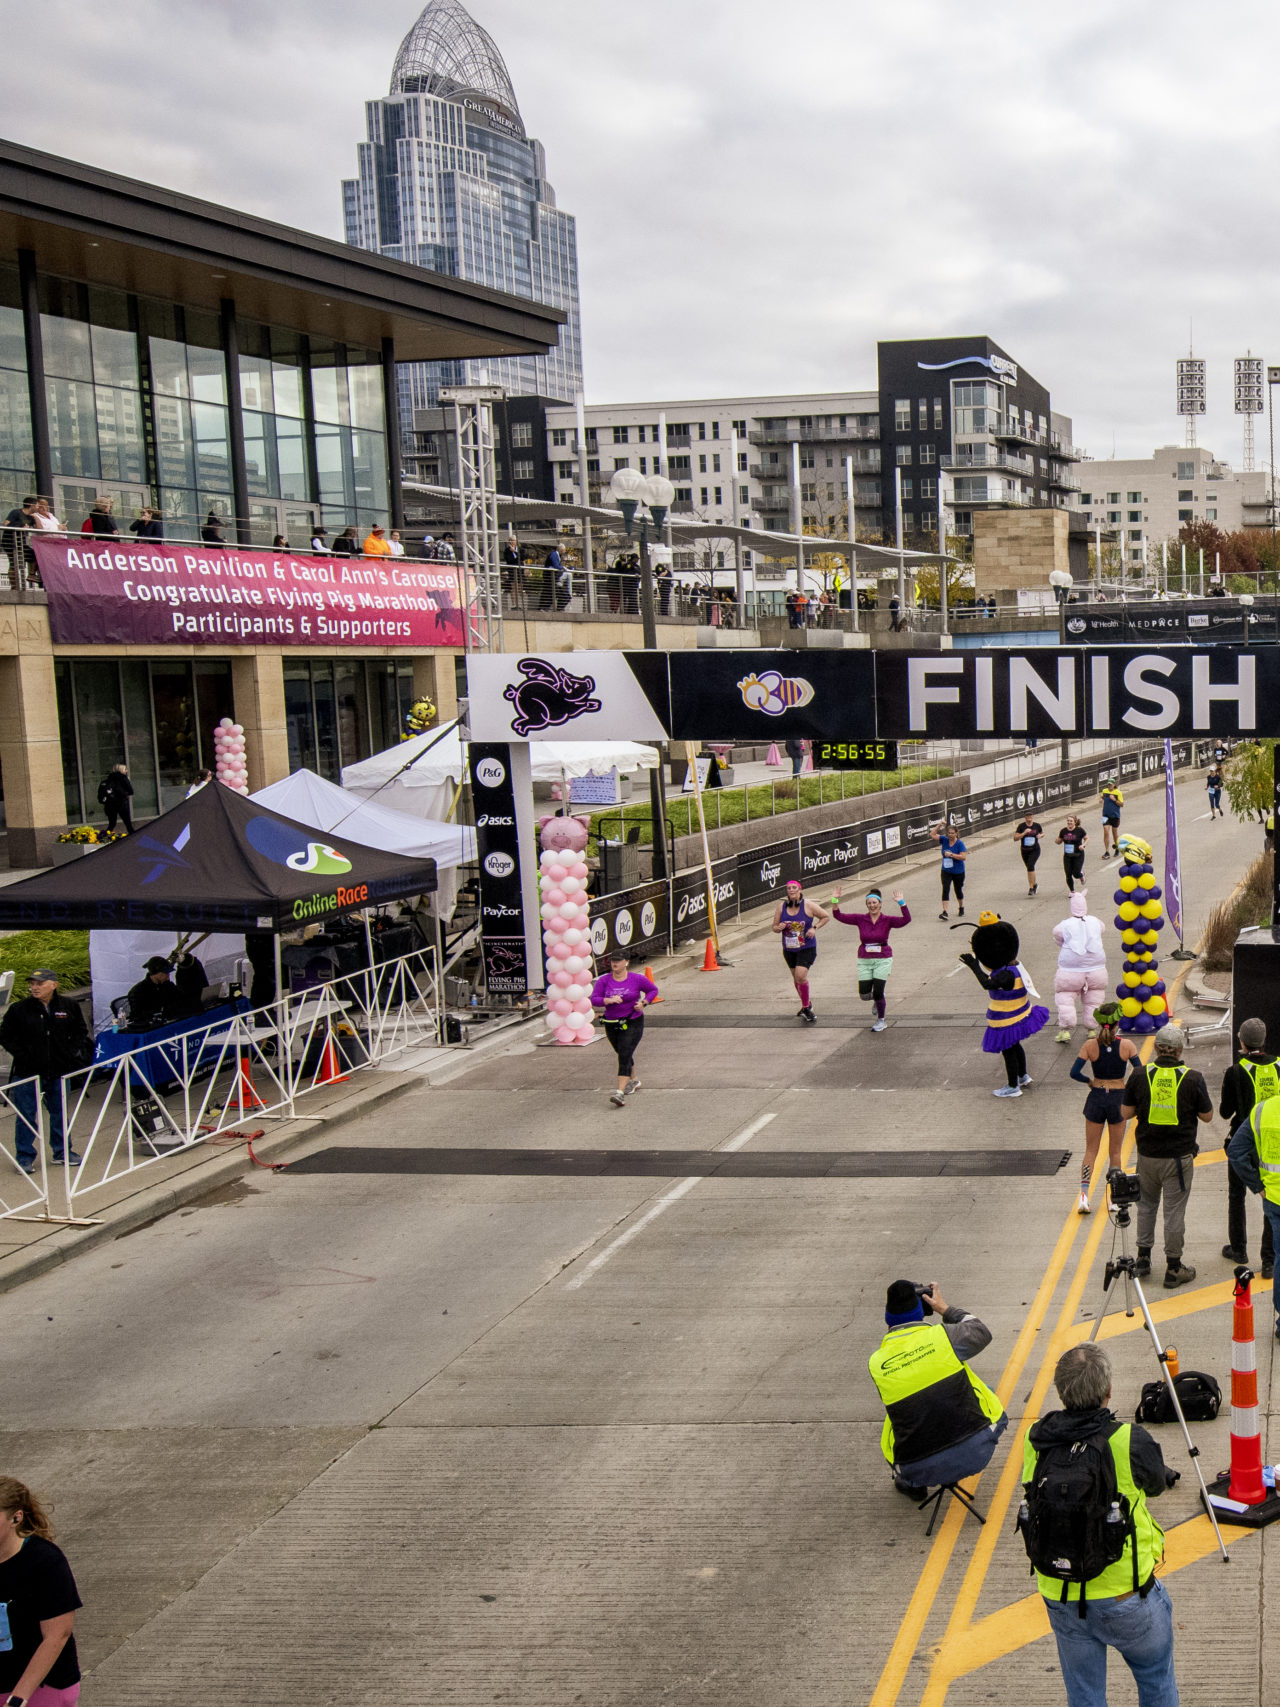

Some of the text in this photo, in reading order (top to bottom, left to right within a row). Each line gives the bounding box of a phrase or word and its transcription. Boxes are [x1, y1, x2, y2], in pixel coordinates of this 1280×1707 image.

[67, 548, 459, 589] Anderson Pavilion & Carol Ann's Carousel
[123, 580, 437, 612] Congratulate Flying Pig Marathon
[172, 611, 411, 638] Participants & Supporters
[1129, 618, 1180, 628] MEDPACE
[907, 655, 1256, 732] FINISH
[482, 767, 502, 777] P&G
[487, 857, 512, 874] Kroger
[803, 845, 859, 872] Paycor Paycor
[760, 860, 781, 888] Kroger
[483, 906, 521, 917] Paycor
[619, 921, 631, 935] P&G
[594, 929, 606, 944] P&G
[488, 976, 526, 984] FLYING PIG
[489, 984, 526, 992] MARATHON
